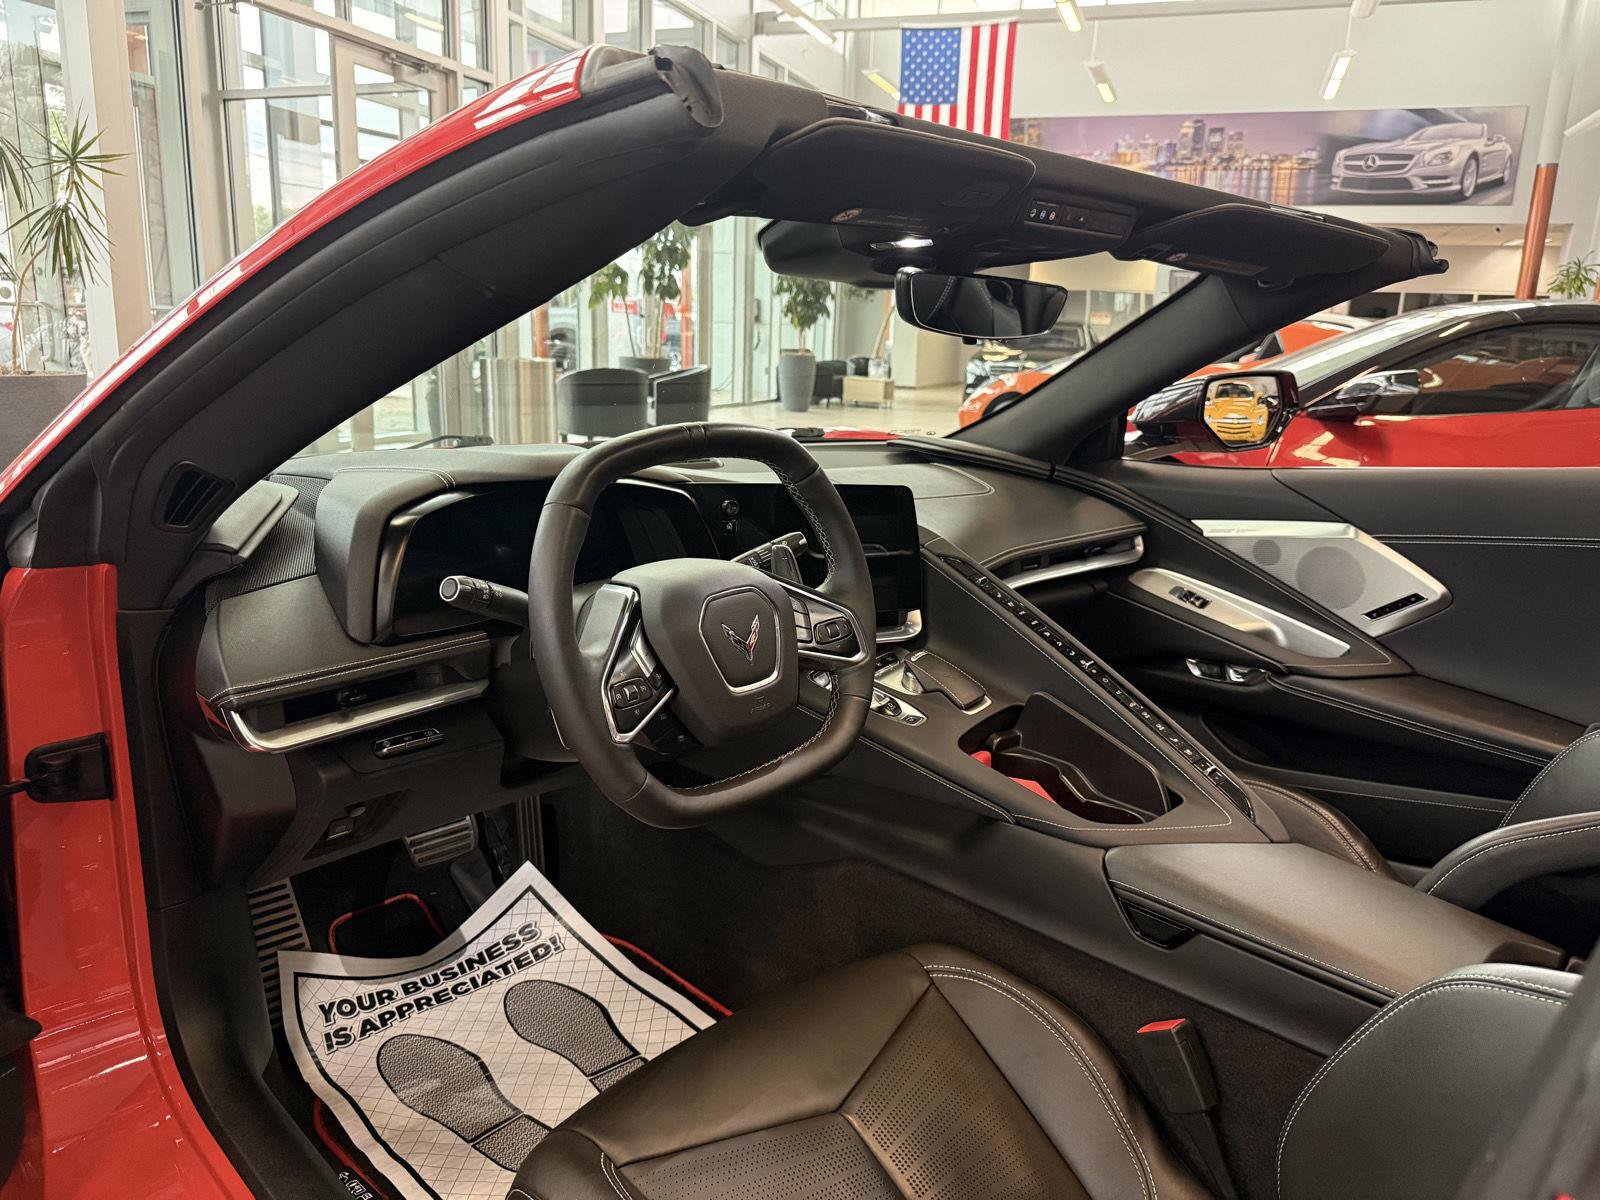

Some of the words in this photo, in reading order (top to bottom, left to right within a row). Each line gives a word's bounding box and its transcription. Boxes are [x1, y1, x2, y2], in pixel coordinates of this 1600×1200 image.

[318, 987, 397, 1025] YOUR
[401, 921, 542, 997] BUSINESS
[323, 1026, 354, 1053] IS
[358, 934, 565, 1039] APPRECIATED!
